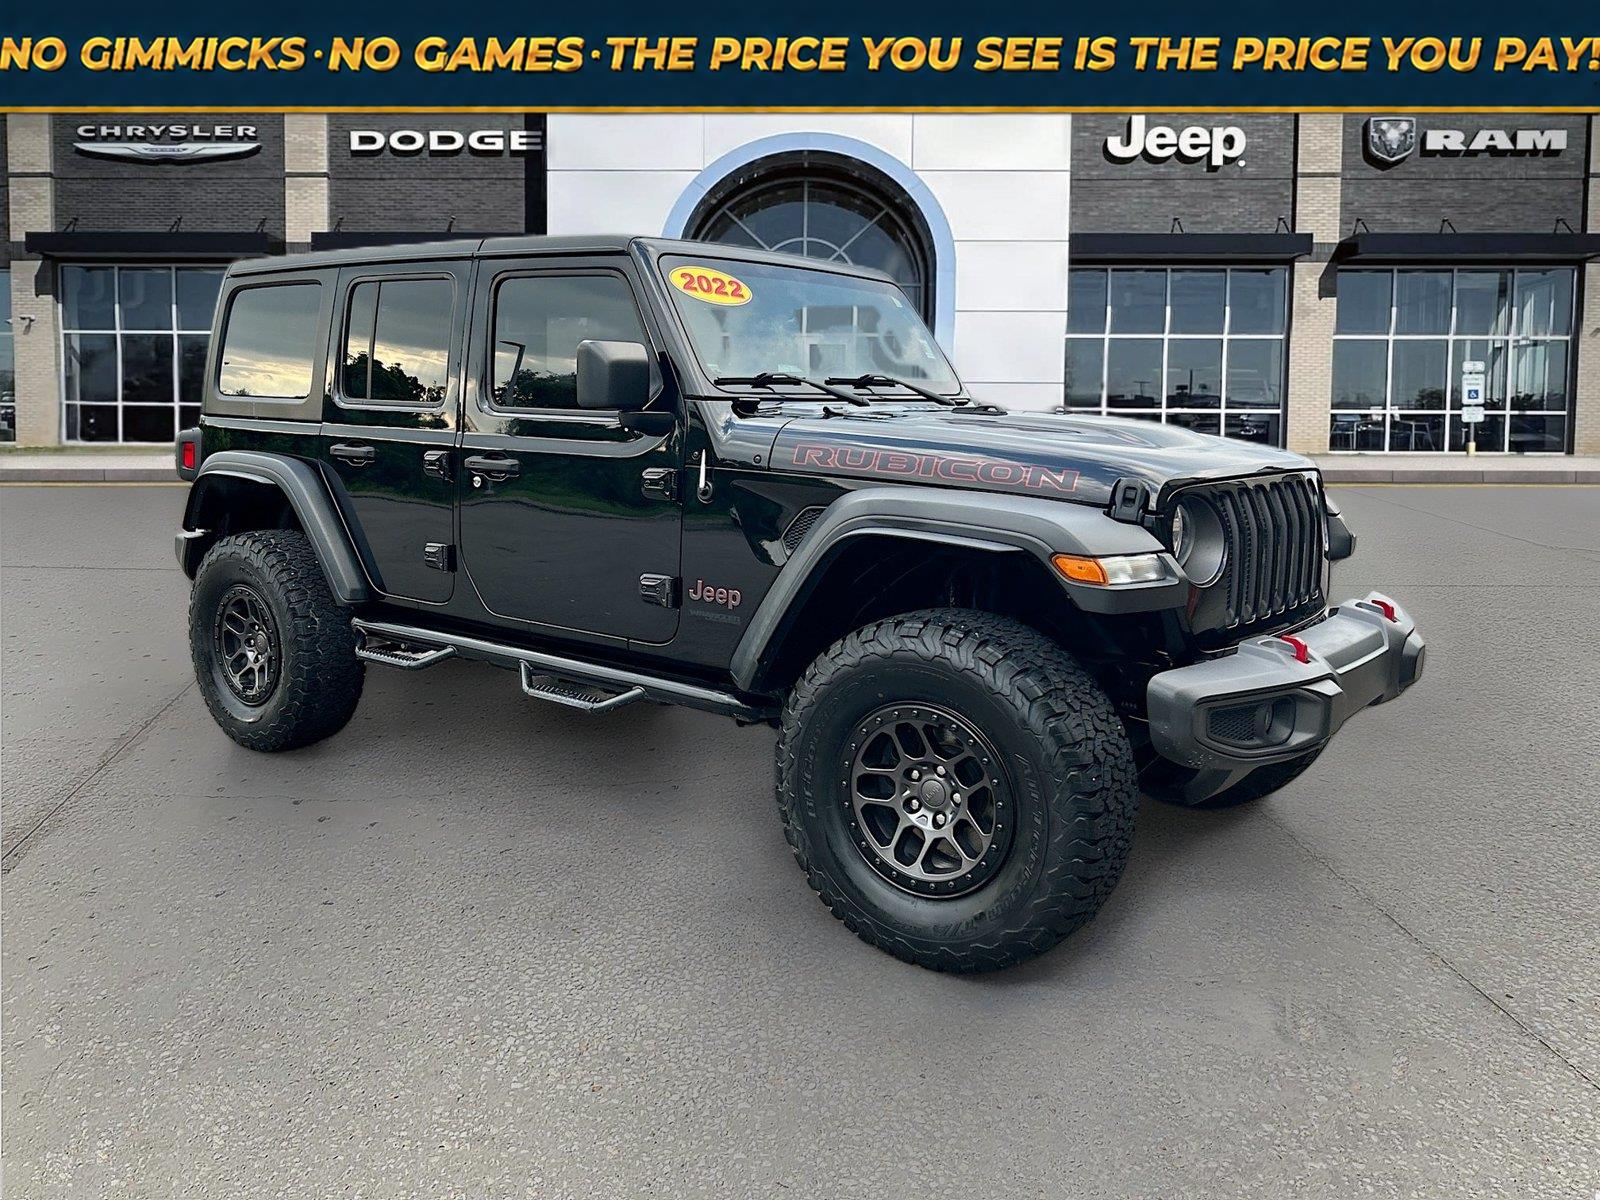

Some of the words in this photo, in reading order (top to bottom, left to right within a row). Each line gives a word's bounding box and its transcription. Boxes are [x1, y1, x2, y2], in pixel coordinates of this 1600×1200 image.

[76, 125, 257, 138] CHRYSLER
[350, 130, 542, 151] DODGE
[1106, 114, 1247, 167] Jeep
[1425, 129, 1568, 151] RAM
[680, 272, 746, 299] 2022
[792, 444, 1081, 493] RUBICON
[688, 579, 742, 610] Jeep
